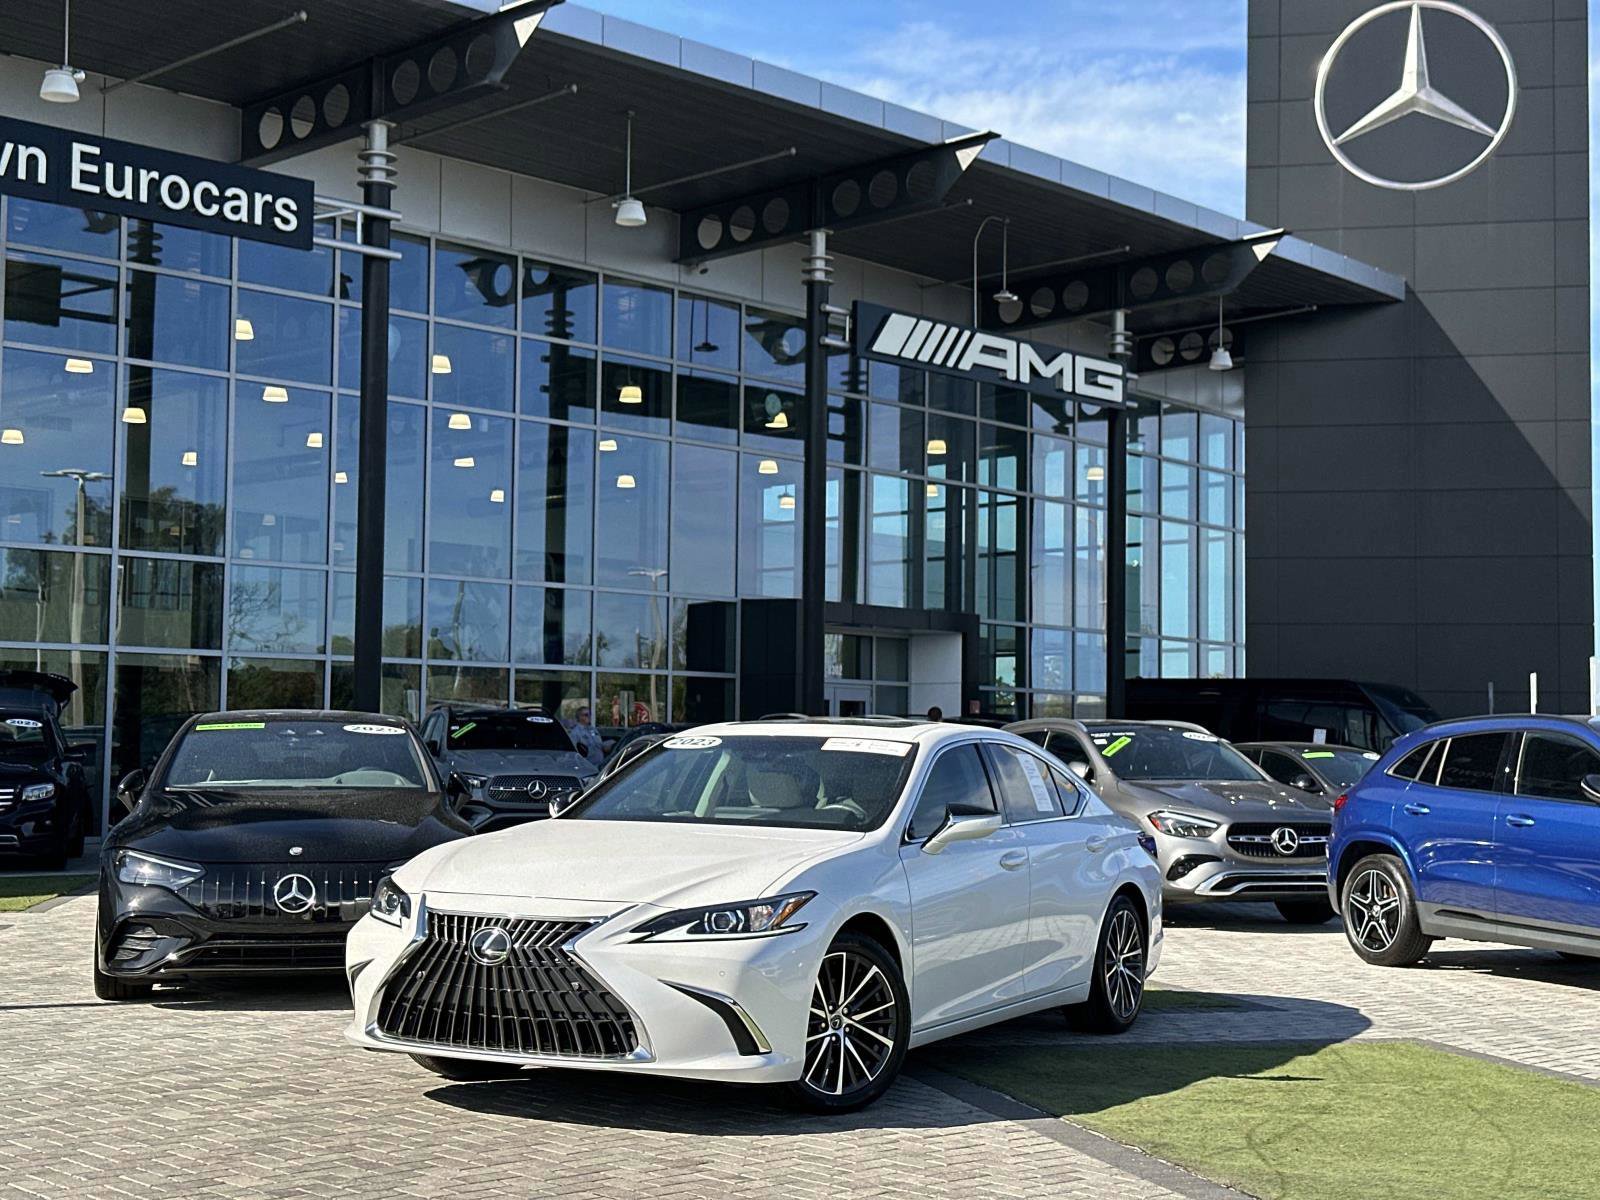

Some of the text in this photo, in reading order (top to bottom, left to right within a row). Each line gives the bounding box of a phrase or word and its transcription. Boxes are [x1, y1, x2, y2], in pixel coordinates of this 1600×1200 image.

[70, 141, 299, 233] Eurocars
[957, 331, 1124, 403] AMG
[669, 738, 717, 747] 2023
